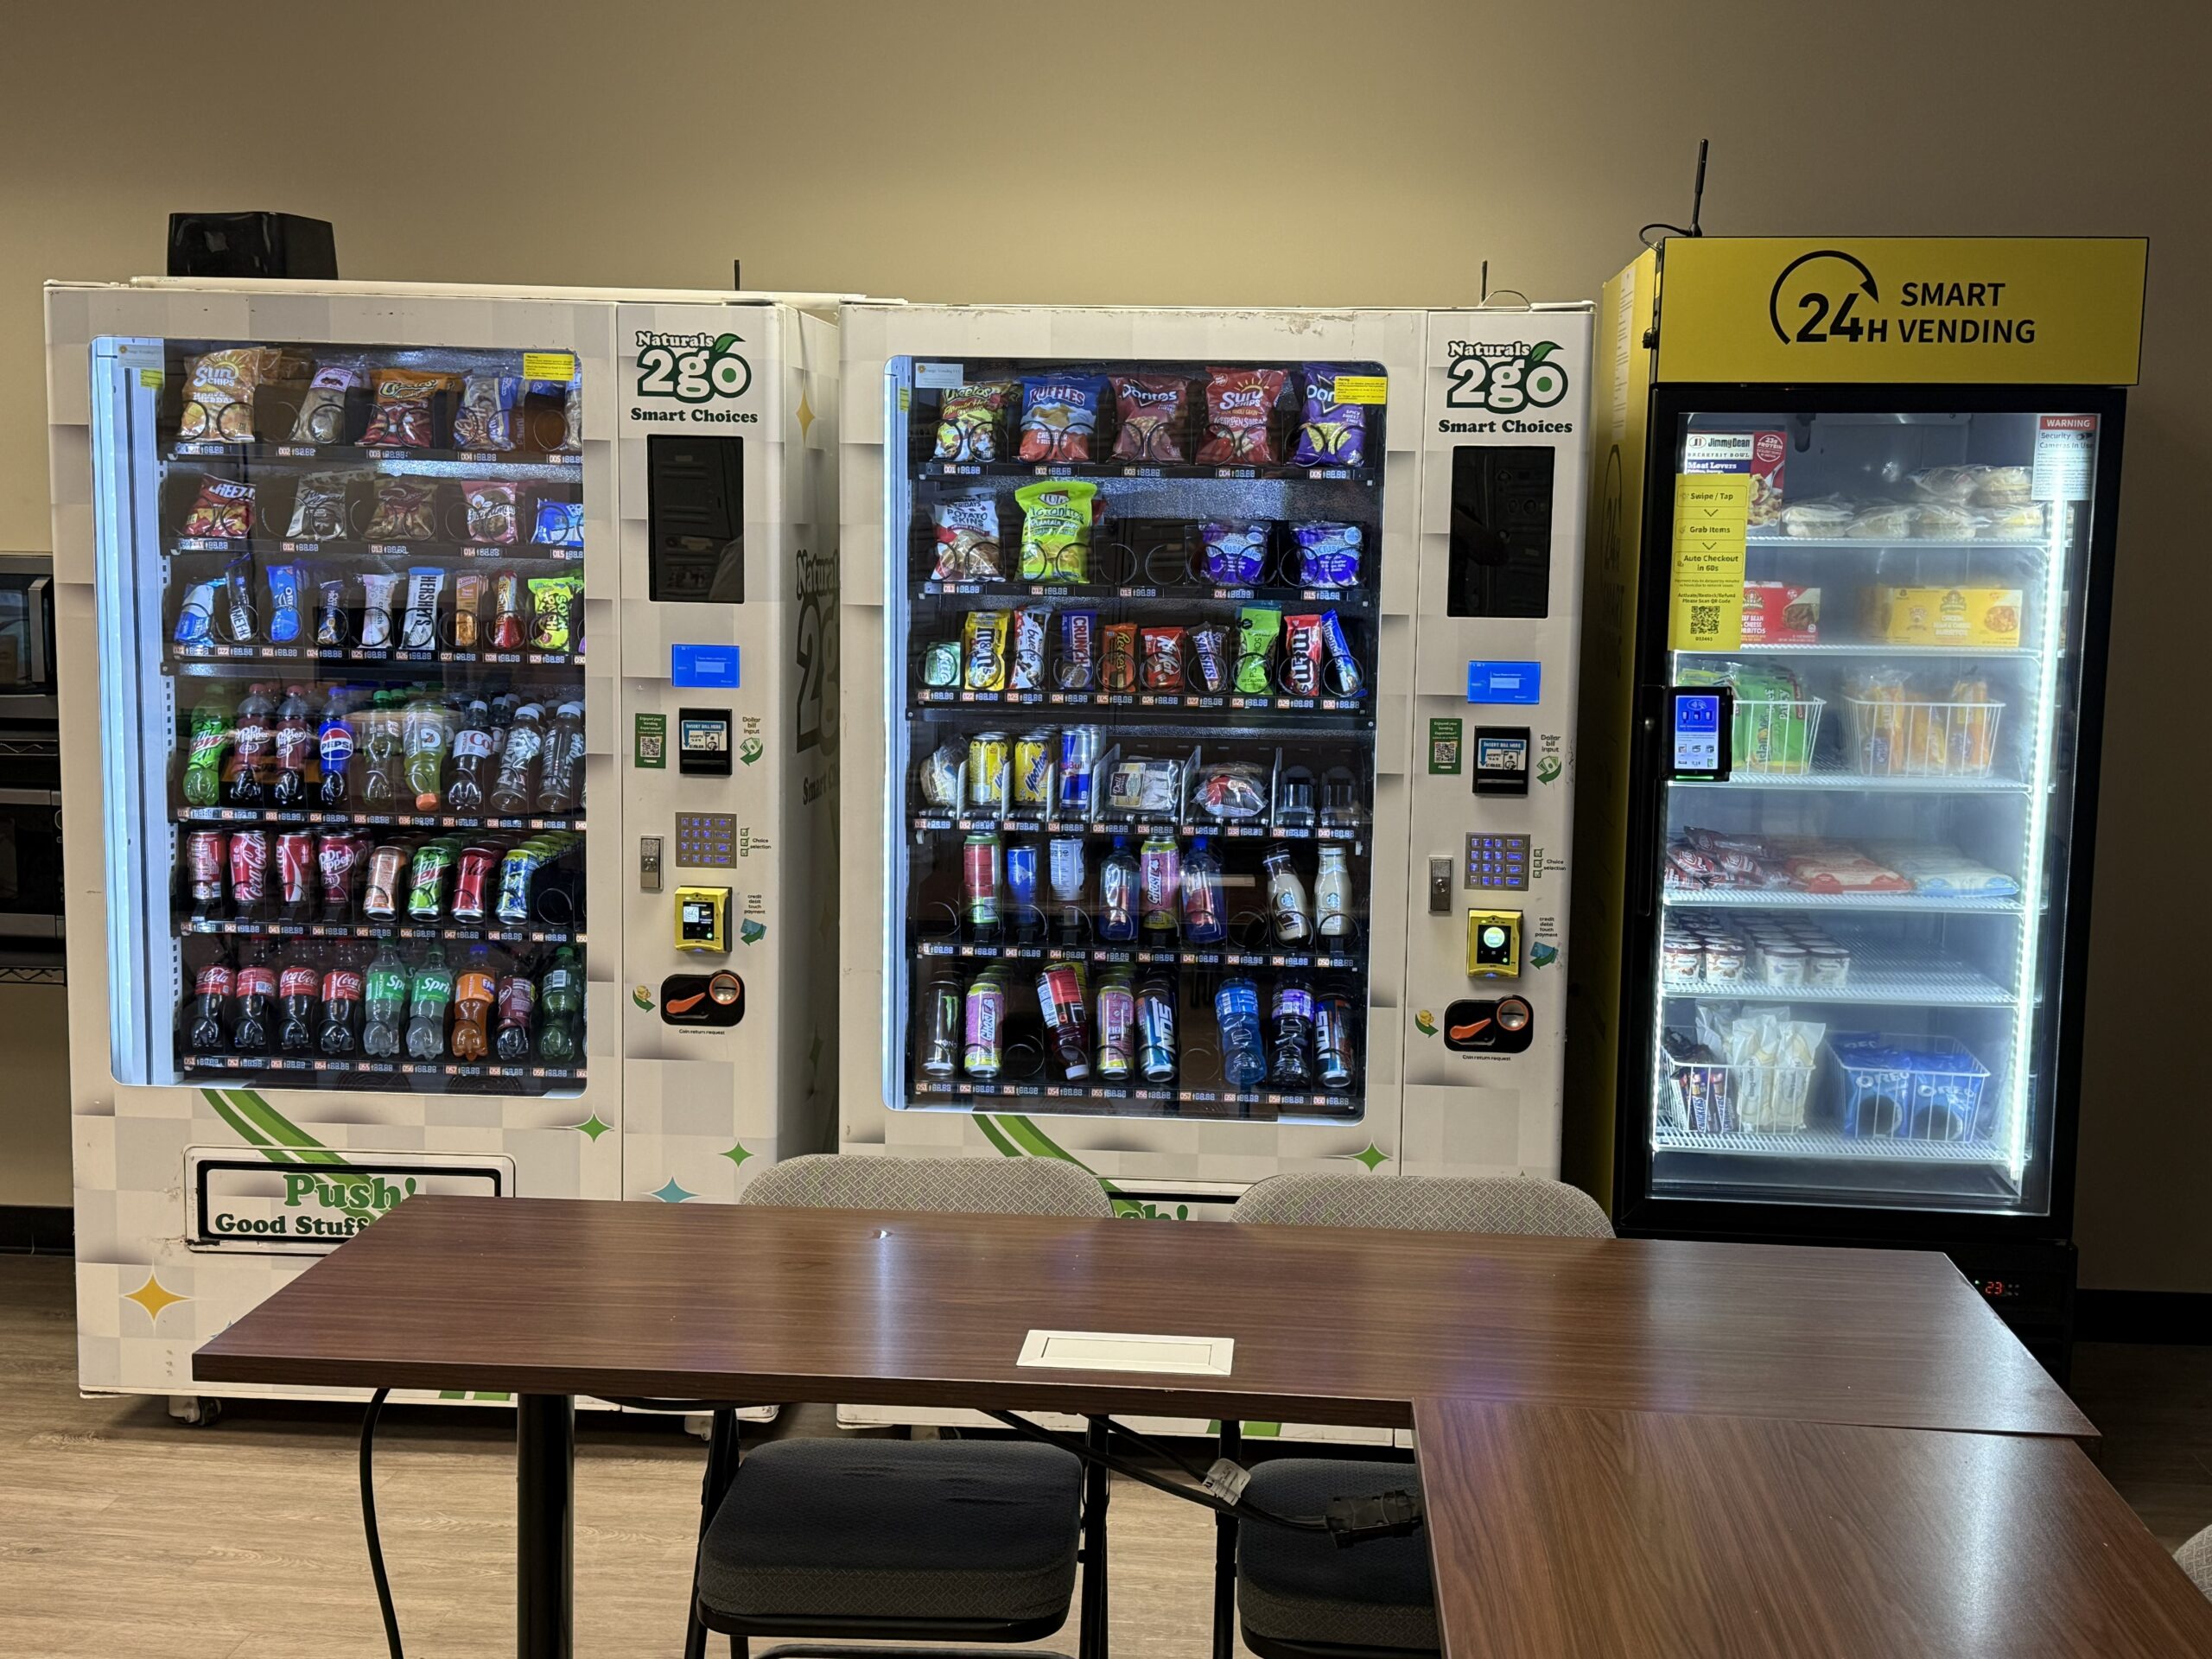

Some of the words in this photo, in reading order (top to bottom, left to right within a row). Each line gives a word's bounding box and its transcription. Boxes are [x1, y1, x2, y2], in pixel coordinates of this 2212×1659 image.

[1901, 283, 2005, 307] SMART
[635, 331, 715, 347] Naturals
[1898, 319, 2035, 344] VENDING
[1447, 340, 1531, 357] Naturals
[193, 366, 237, 386] Sun
[207, 377, 235, 386] CHIPS
[637, 346, 752, 404] 2go
[1446, 354, 1568, 414] 2go
[1028, 385, 1087, 409] RUFFLES
[1122, 385, 1178, 403] Doritos
[1219, 391, 1264, 410] Sun
[1234, 398, 1261, 407] CHIPS
[631, 408, 686, 422] Smart
[691, 409, 758, 423] Choices
[2046, 419, 2090, 428] WARNING
[1439, 420, 1496, 433] Smart
[1502, 419, 1573, 433] Choices
[1758, 442, 1783, 450] PROTEIN
[1690, 493, 1713, 501] Swipe
[1720, 493, 1733, 501] Tap
[947, 508, 988, 520] POTATO
[951, 516, 983, 527] SKINS
[795, 549, 840, 598] Natural
[1026, 628, 1039, 663] bueno
[321, 741, 353, 751] PEPSI
[1069, 760, 1084, 769] Bull
[325, 849, 341, 861] Dr
[1856, 1071, 1910, 1089] OREO
[215, 1214, 286, 1233] Good
[1985, 1281, 2003, 1294] 23
